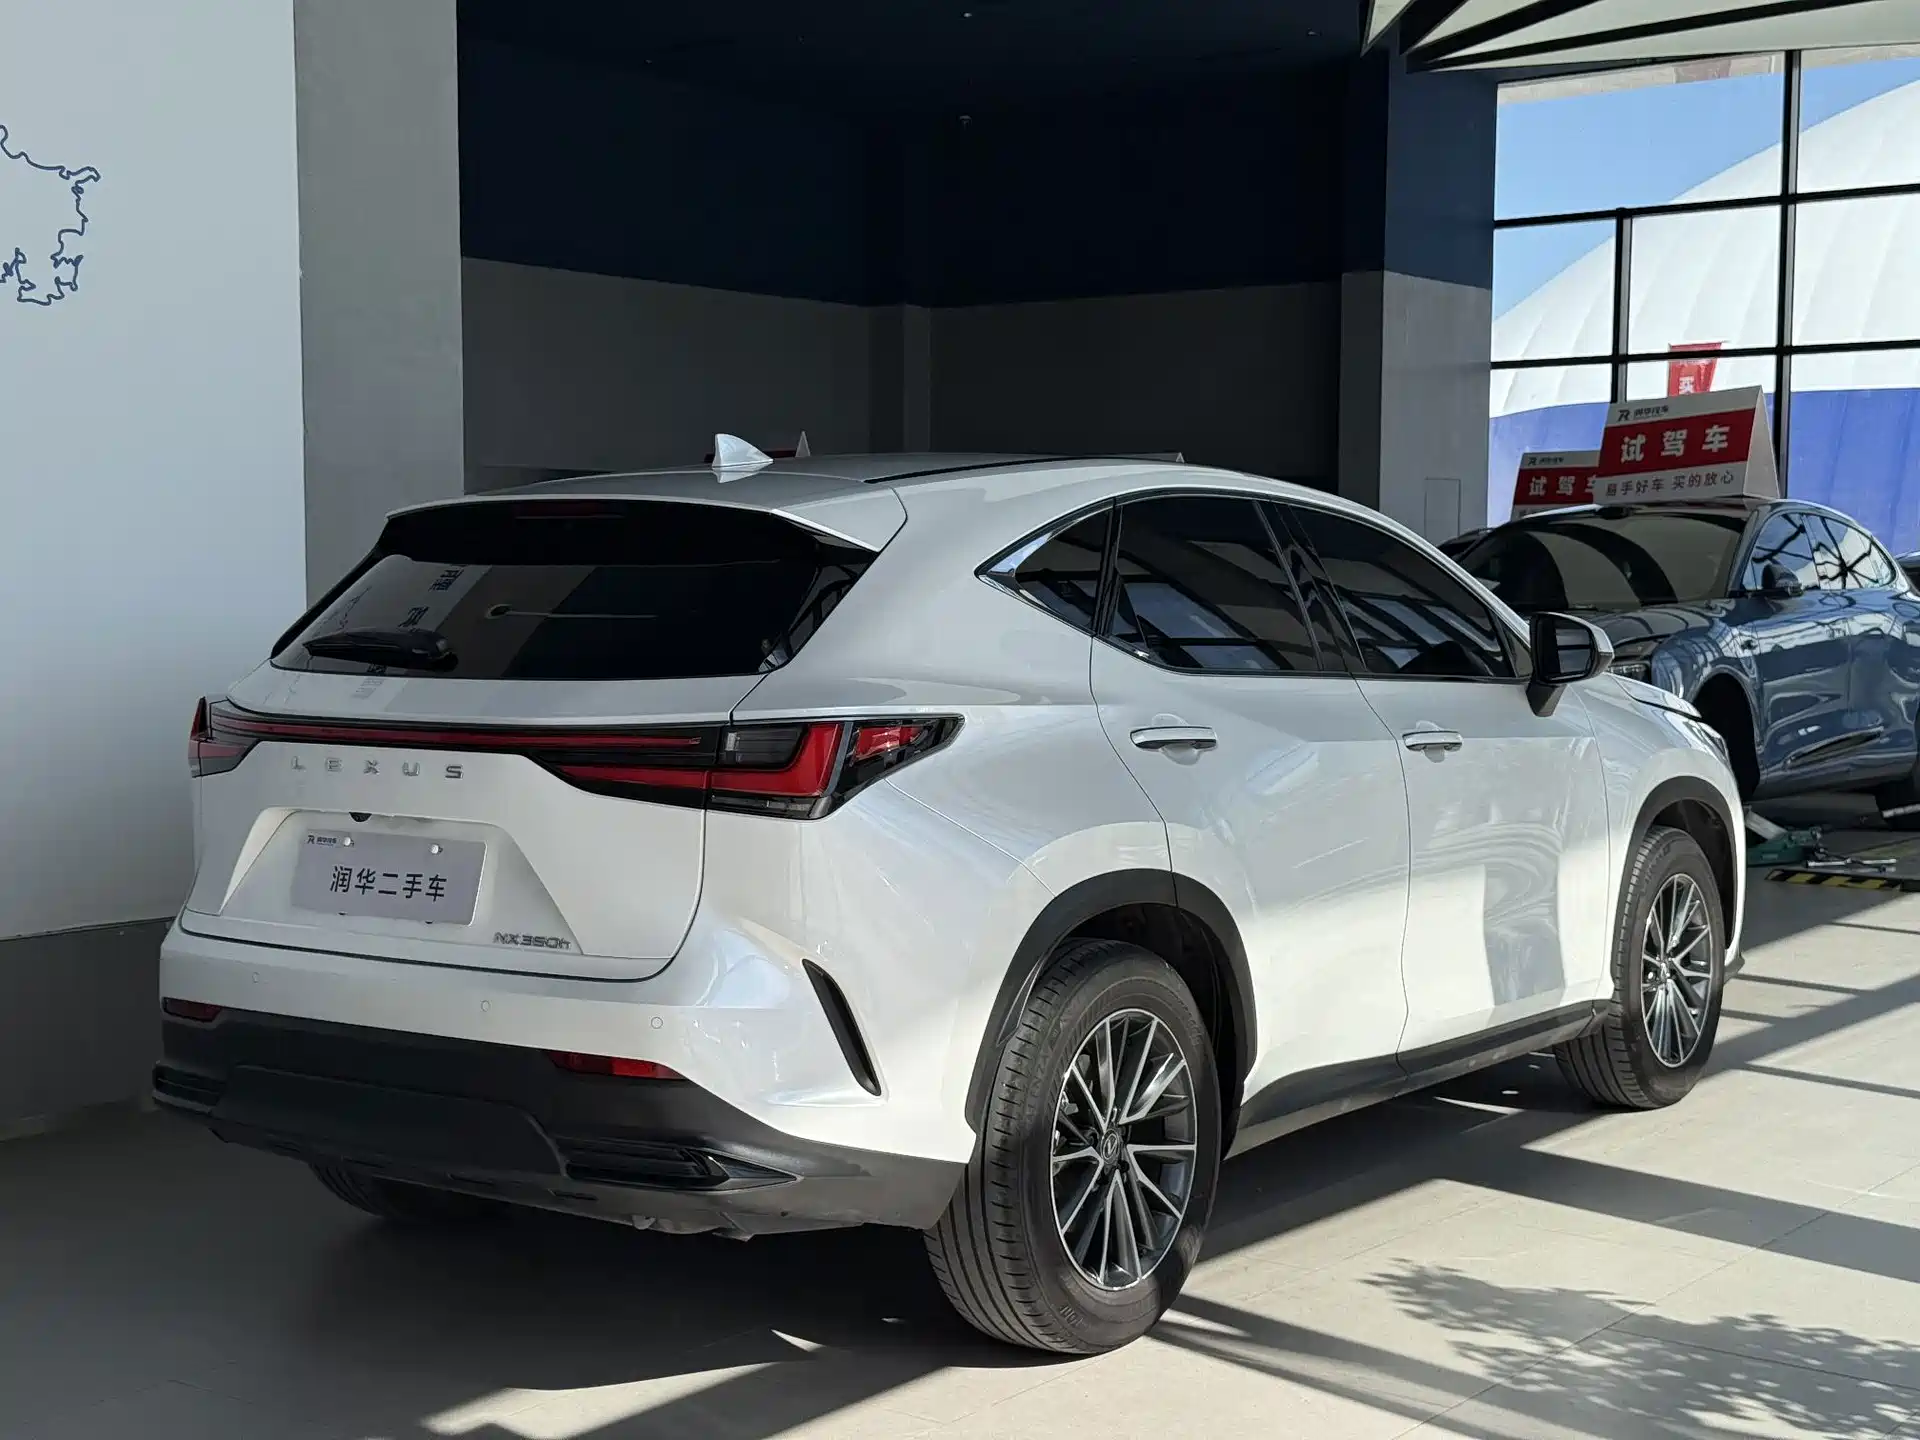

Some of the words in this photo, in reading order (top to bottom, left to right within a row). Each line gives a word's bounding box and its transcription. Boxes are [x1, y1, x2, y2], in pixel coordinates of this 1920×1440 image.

[1620, 424, 1731, 463] 试驾车
[291, 755, 464, 780] LEXUS
[330, 864, 447, 902] 润华二手车
[493, 931, 571, 950] NX350h
